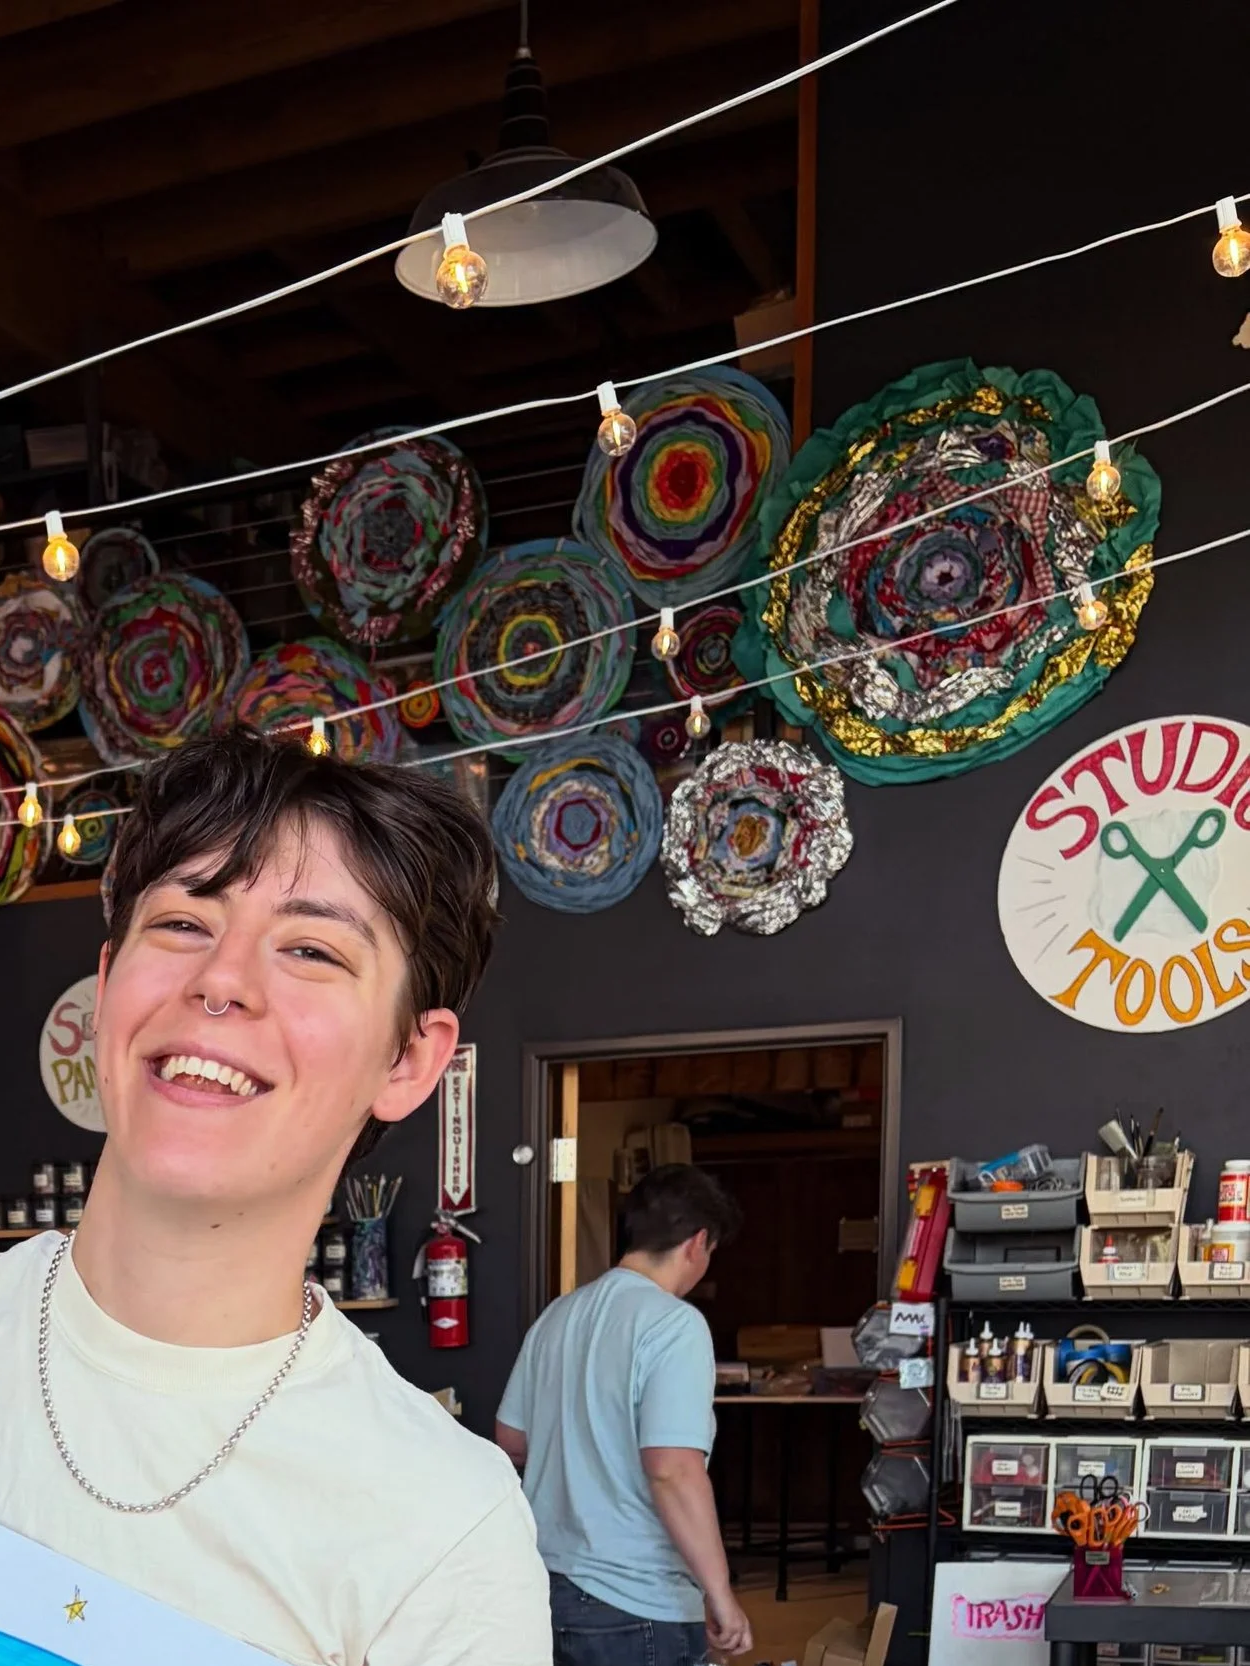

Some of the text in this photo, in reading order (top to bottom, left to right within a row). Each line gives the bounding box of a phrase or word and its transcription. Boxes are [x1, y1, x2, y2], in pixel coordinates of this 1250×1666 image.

[1049, 918, 1250, 1027] TOOLS
[452, 1075, 462, 1194] EXTINGUISHER
[967, 1599, 1044, 1631] TRASH
